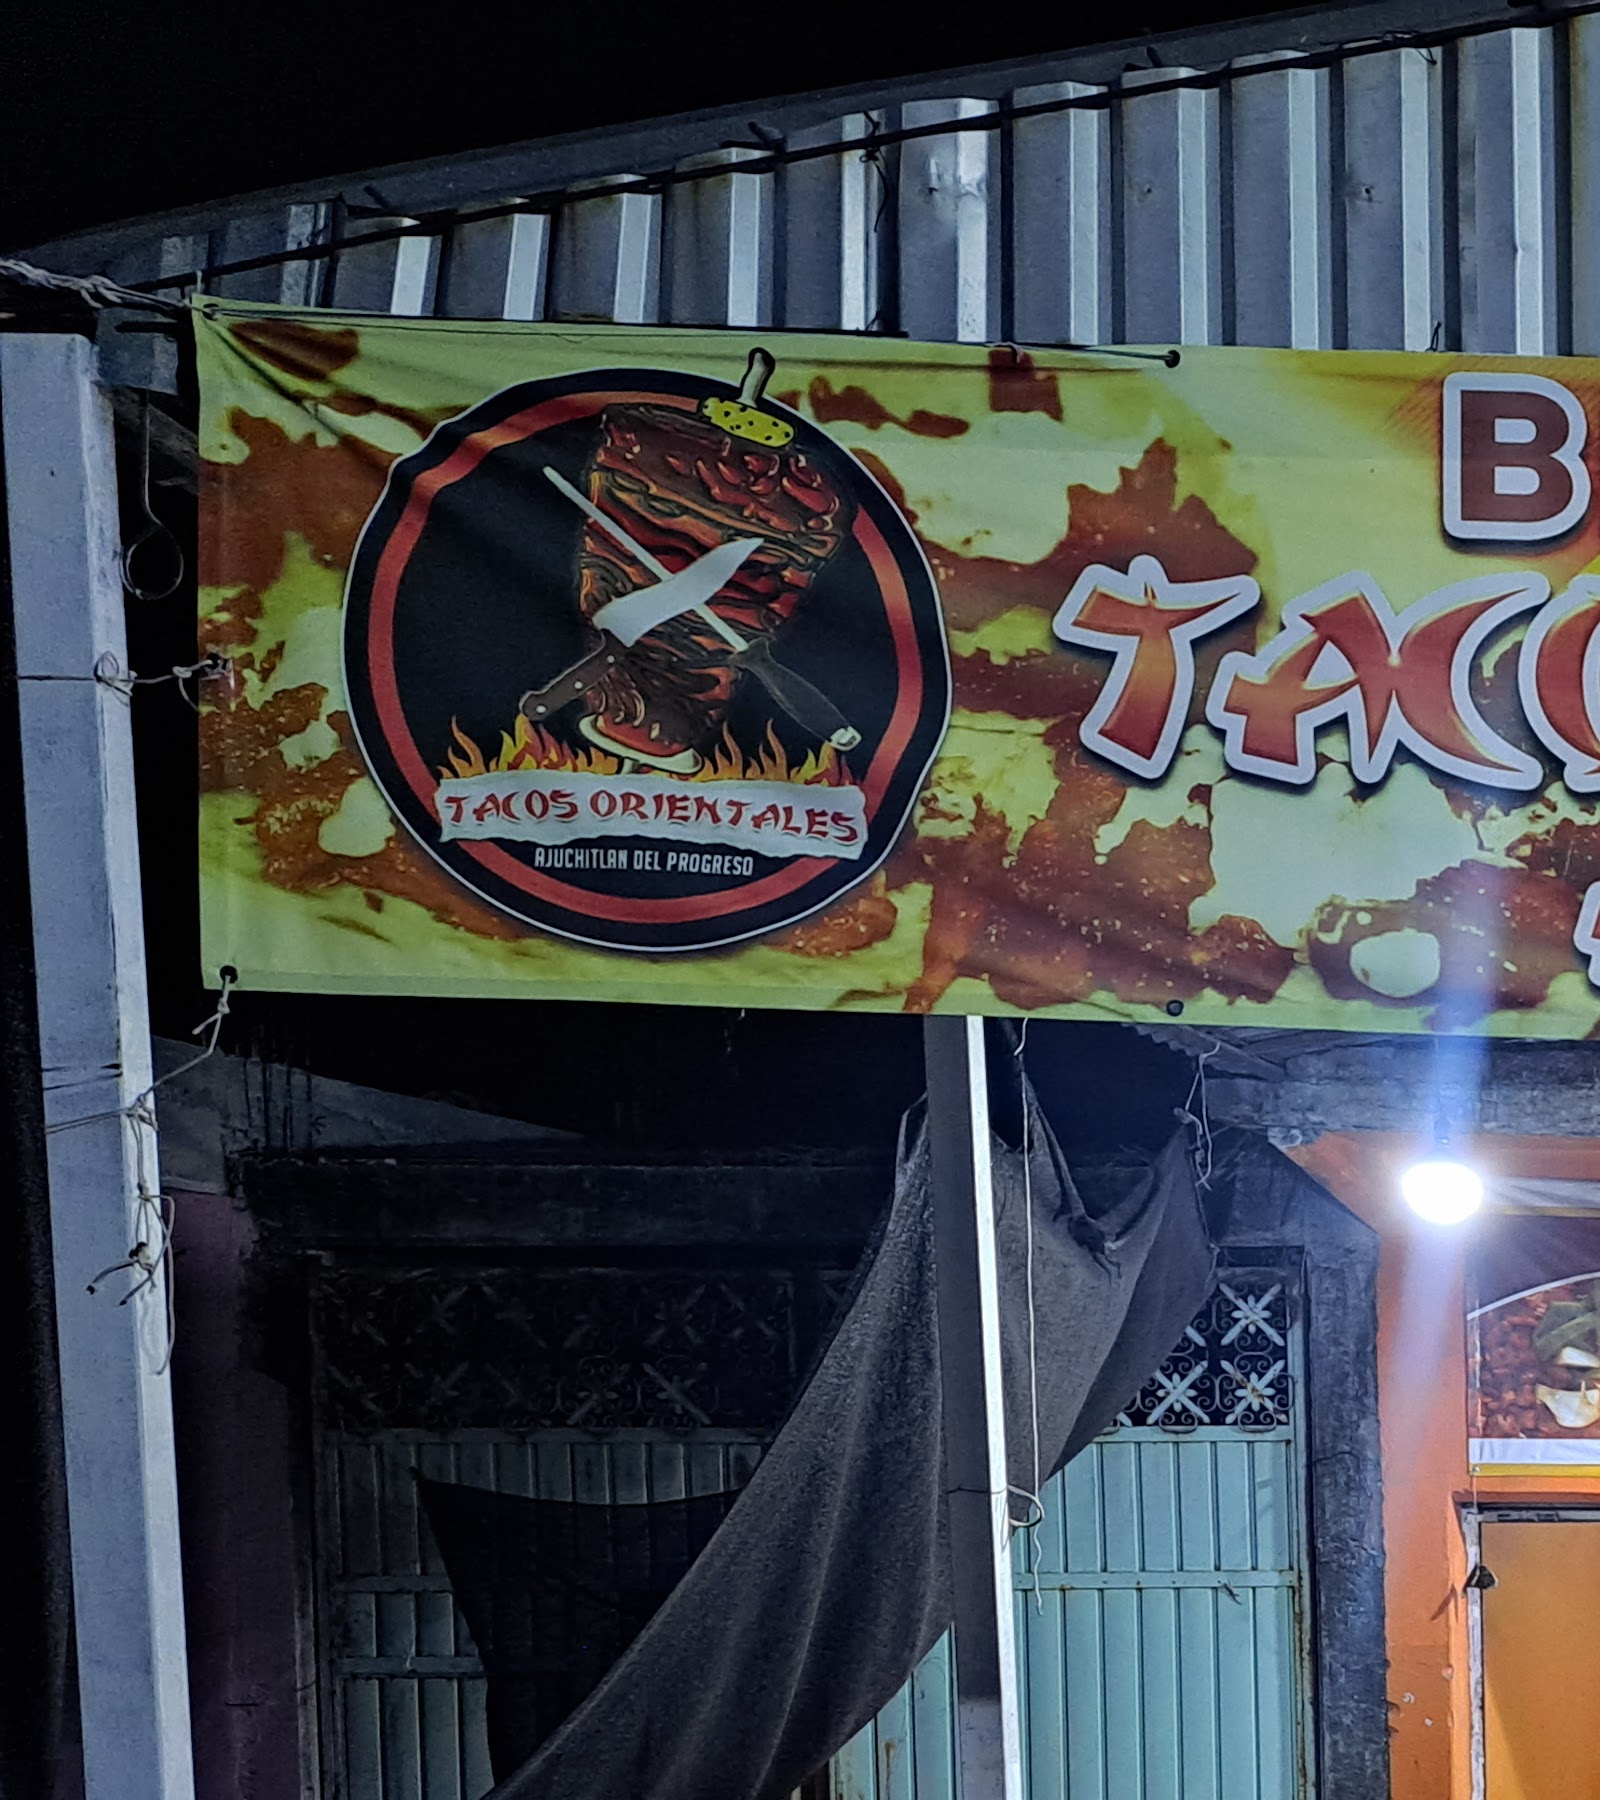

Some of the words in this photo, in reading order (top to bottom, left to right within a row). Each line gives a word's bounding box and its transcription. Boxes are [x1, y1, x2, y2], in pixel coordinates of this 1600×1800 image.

[444, 788, 577, 825] TACOS
[589, 789, 860, 845] ORIENTALES
[534, 846, 627, 869] AJUCHITLAN
[633, 850, 662, 871] DEL
[666, 853, 753, 876] PROGRESO
